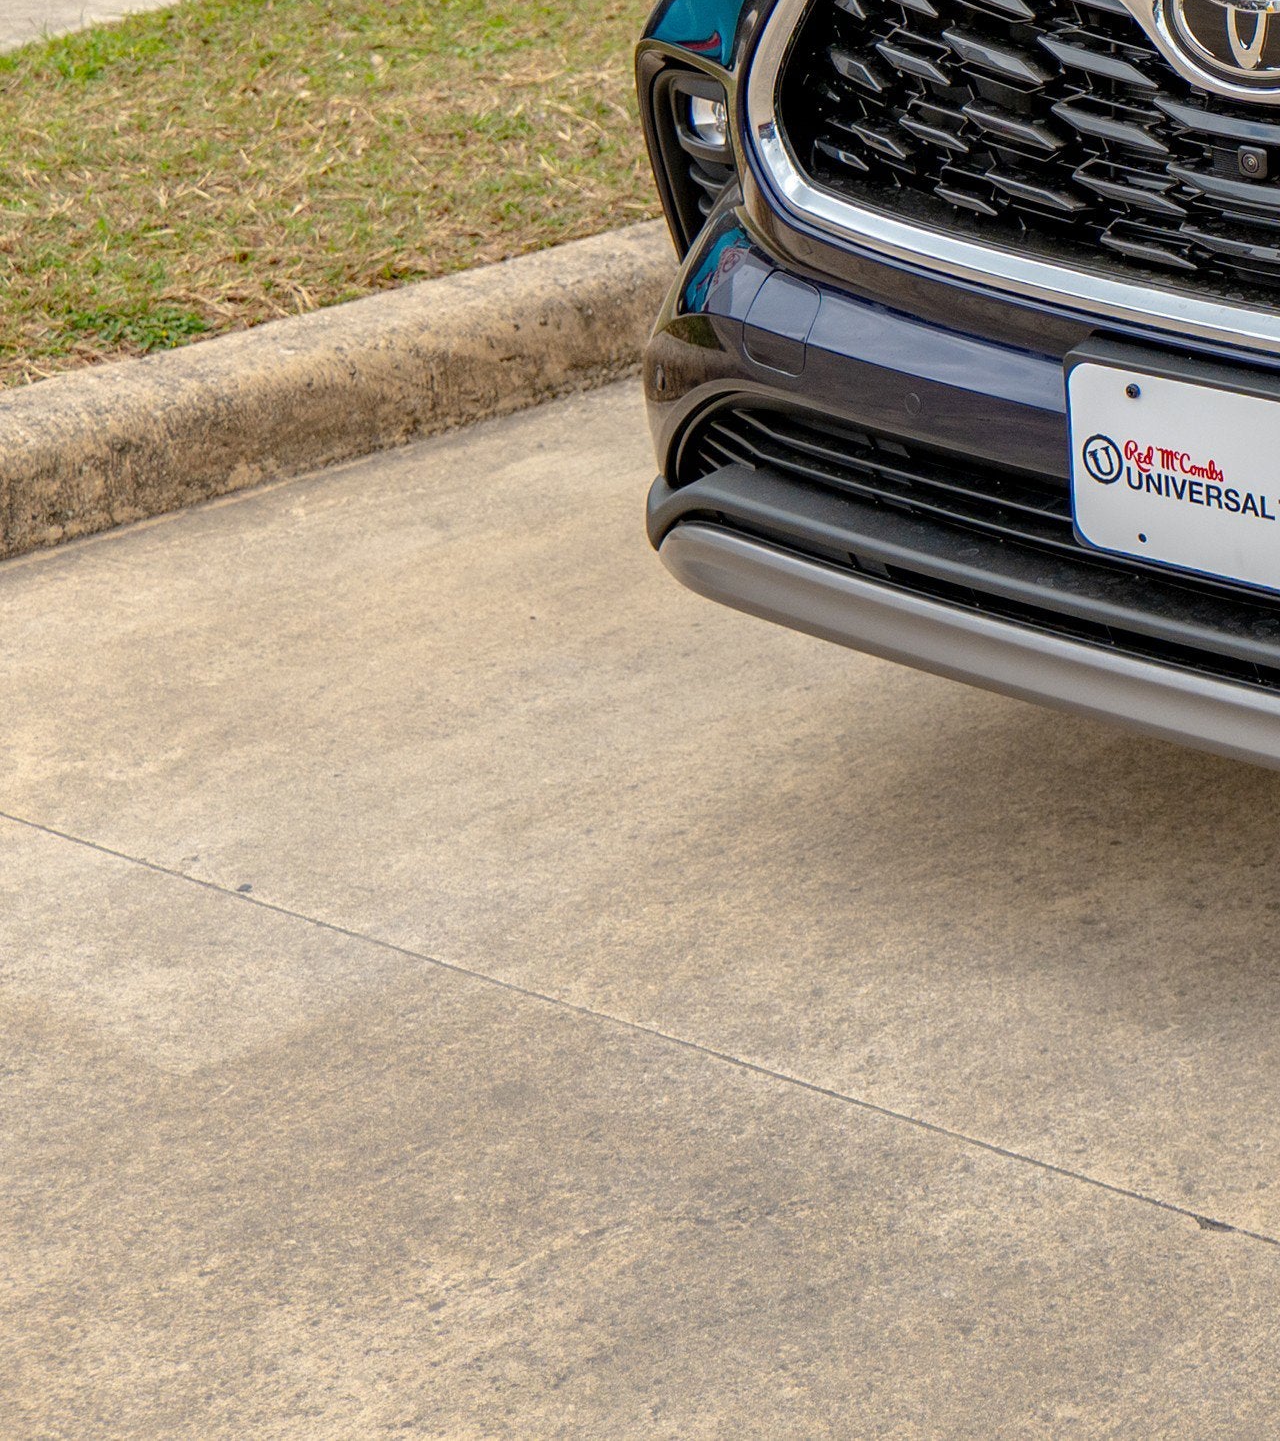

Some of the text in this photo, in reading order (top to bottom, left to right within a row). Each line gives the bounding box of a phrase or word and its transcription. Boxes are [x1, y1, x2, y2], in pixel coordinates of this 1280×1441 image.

[1124, 439, 1224, 483] Red McCombs
[1126, 465, 1276, 521] UNIVERSAL
